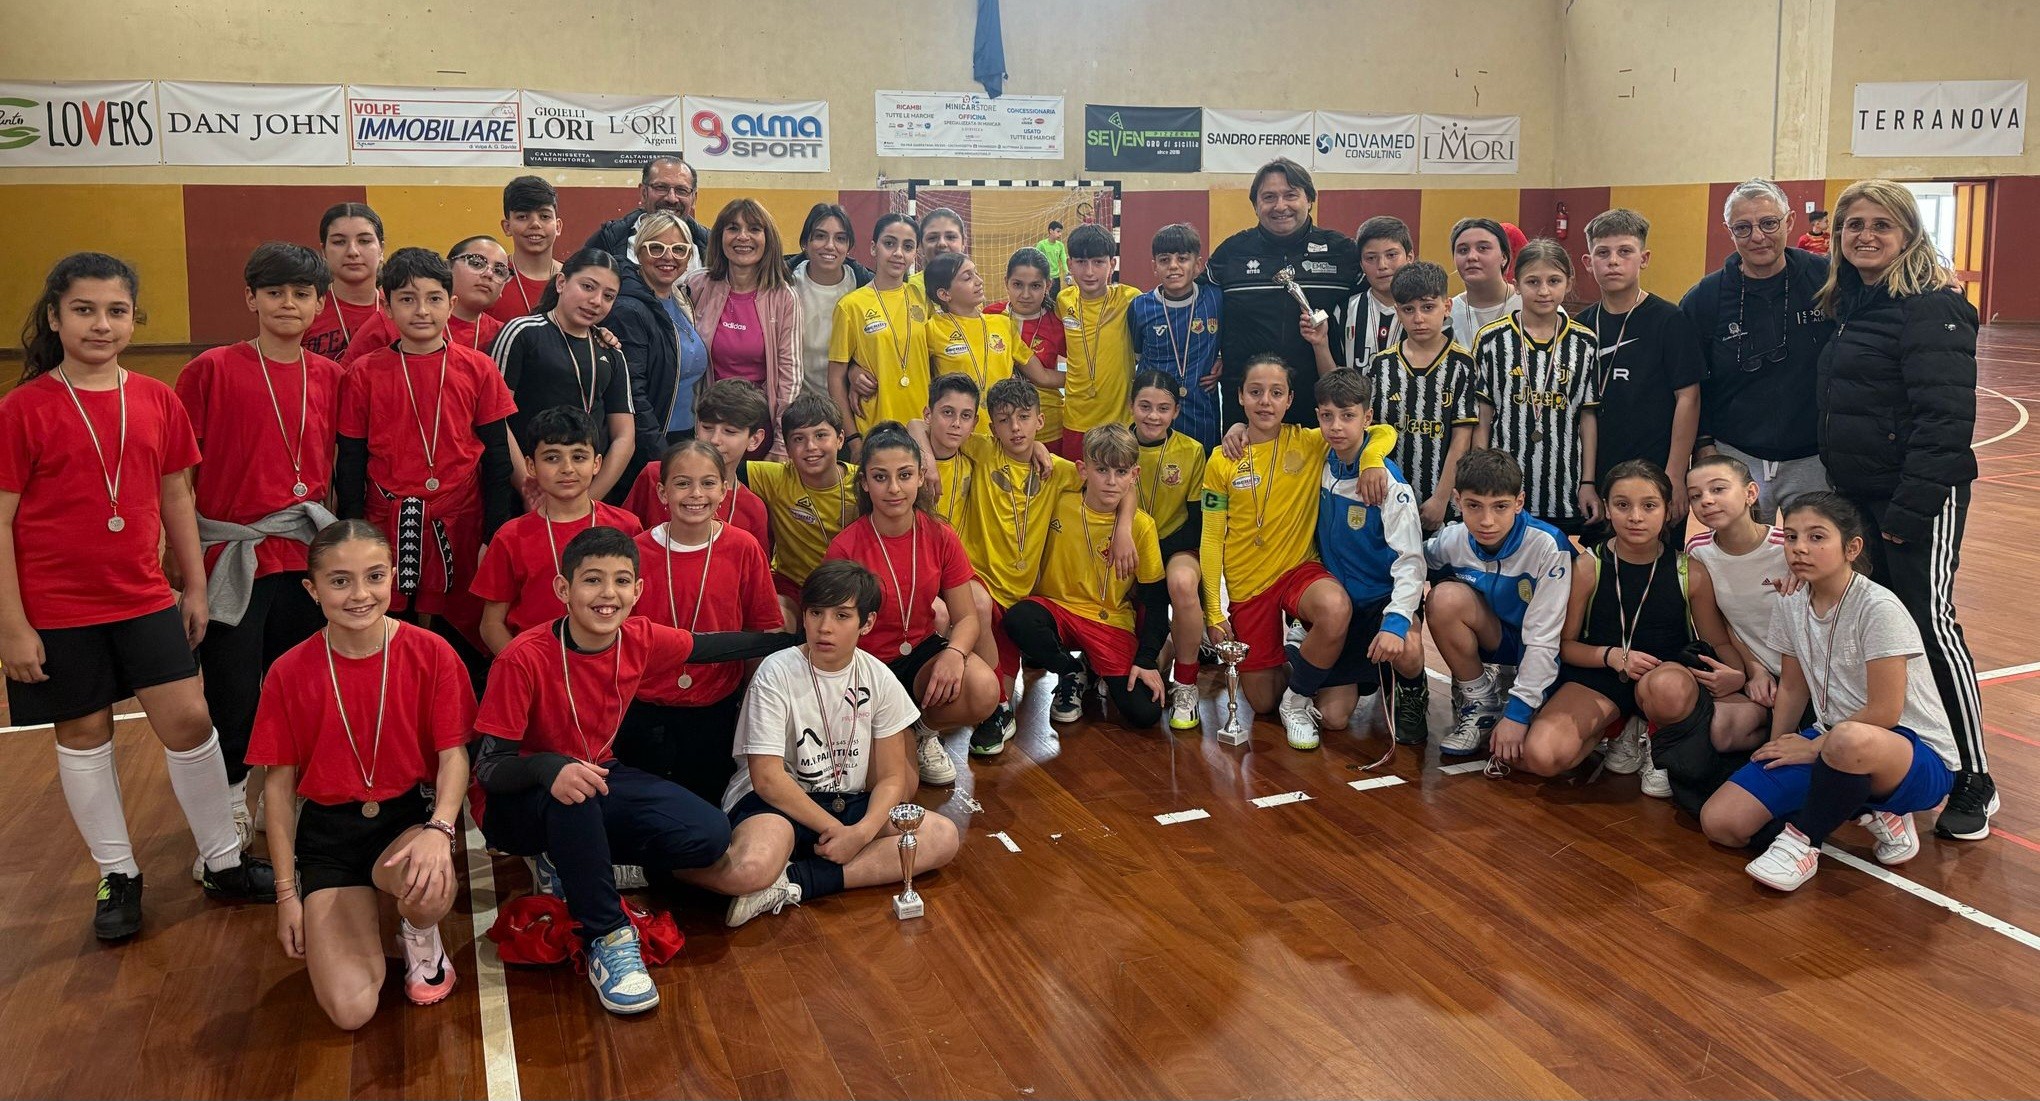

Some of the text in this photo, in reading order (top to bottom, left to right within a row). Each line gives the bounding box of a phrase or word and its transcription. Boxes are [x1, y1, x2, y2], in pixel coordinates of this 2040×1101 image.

[354, 103, 401, 115] VOLPE
[534, 106, 585, 118] GIOIELLI
[945, 103, 997, 112] MINICARSTORE
[1006, 107, 1056, 115] CONCESSIONARIA
[46, 100, 154, 147] LOVERS
[731, 113, 822, 138] alma
[958, 113, 987, 121] OFFICINA
[1858, 107, 2020, 131] TERRANOVA
[167, 112, 341, 141] DAN JOHN
[357, 118, 517, 142] IMMOBILIARE
[527, 117, 595, 141] LORI
[644, 136, 677, 147] Argenti
[1087, 129, 1145, 157] SEVEN
[1207, 132, 1311, 146] SANDRO FERRONE
[1335, 132, 1415, 149] NOVAMED
[731, 141, 823, 158] SPORT
[1345, 149, 1402, 159] CONSULTING
[722, 321, 747, 331] adidas
[1394, 415, 1445, 439] Jeep
